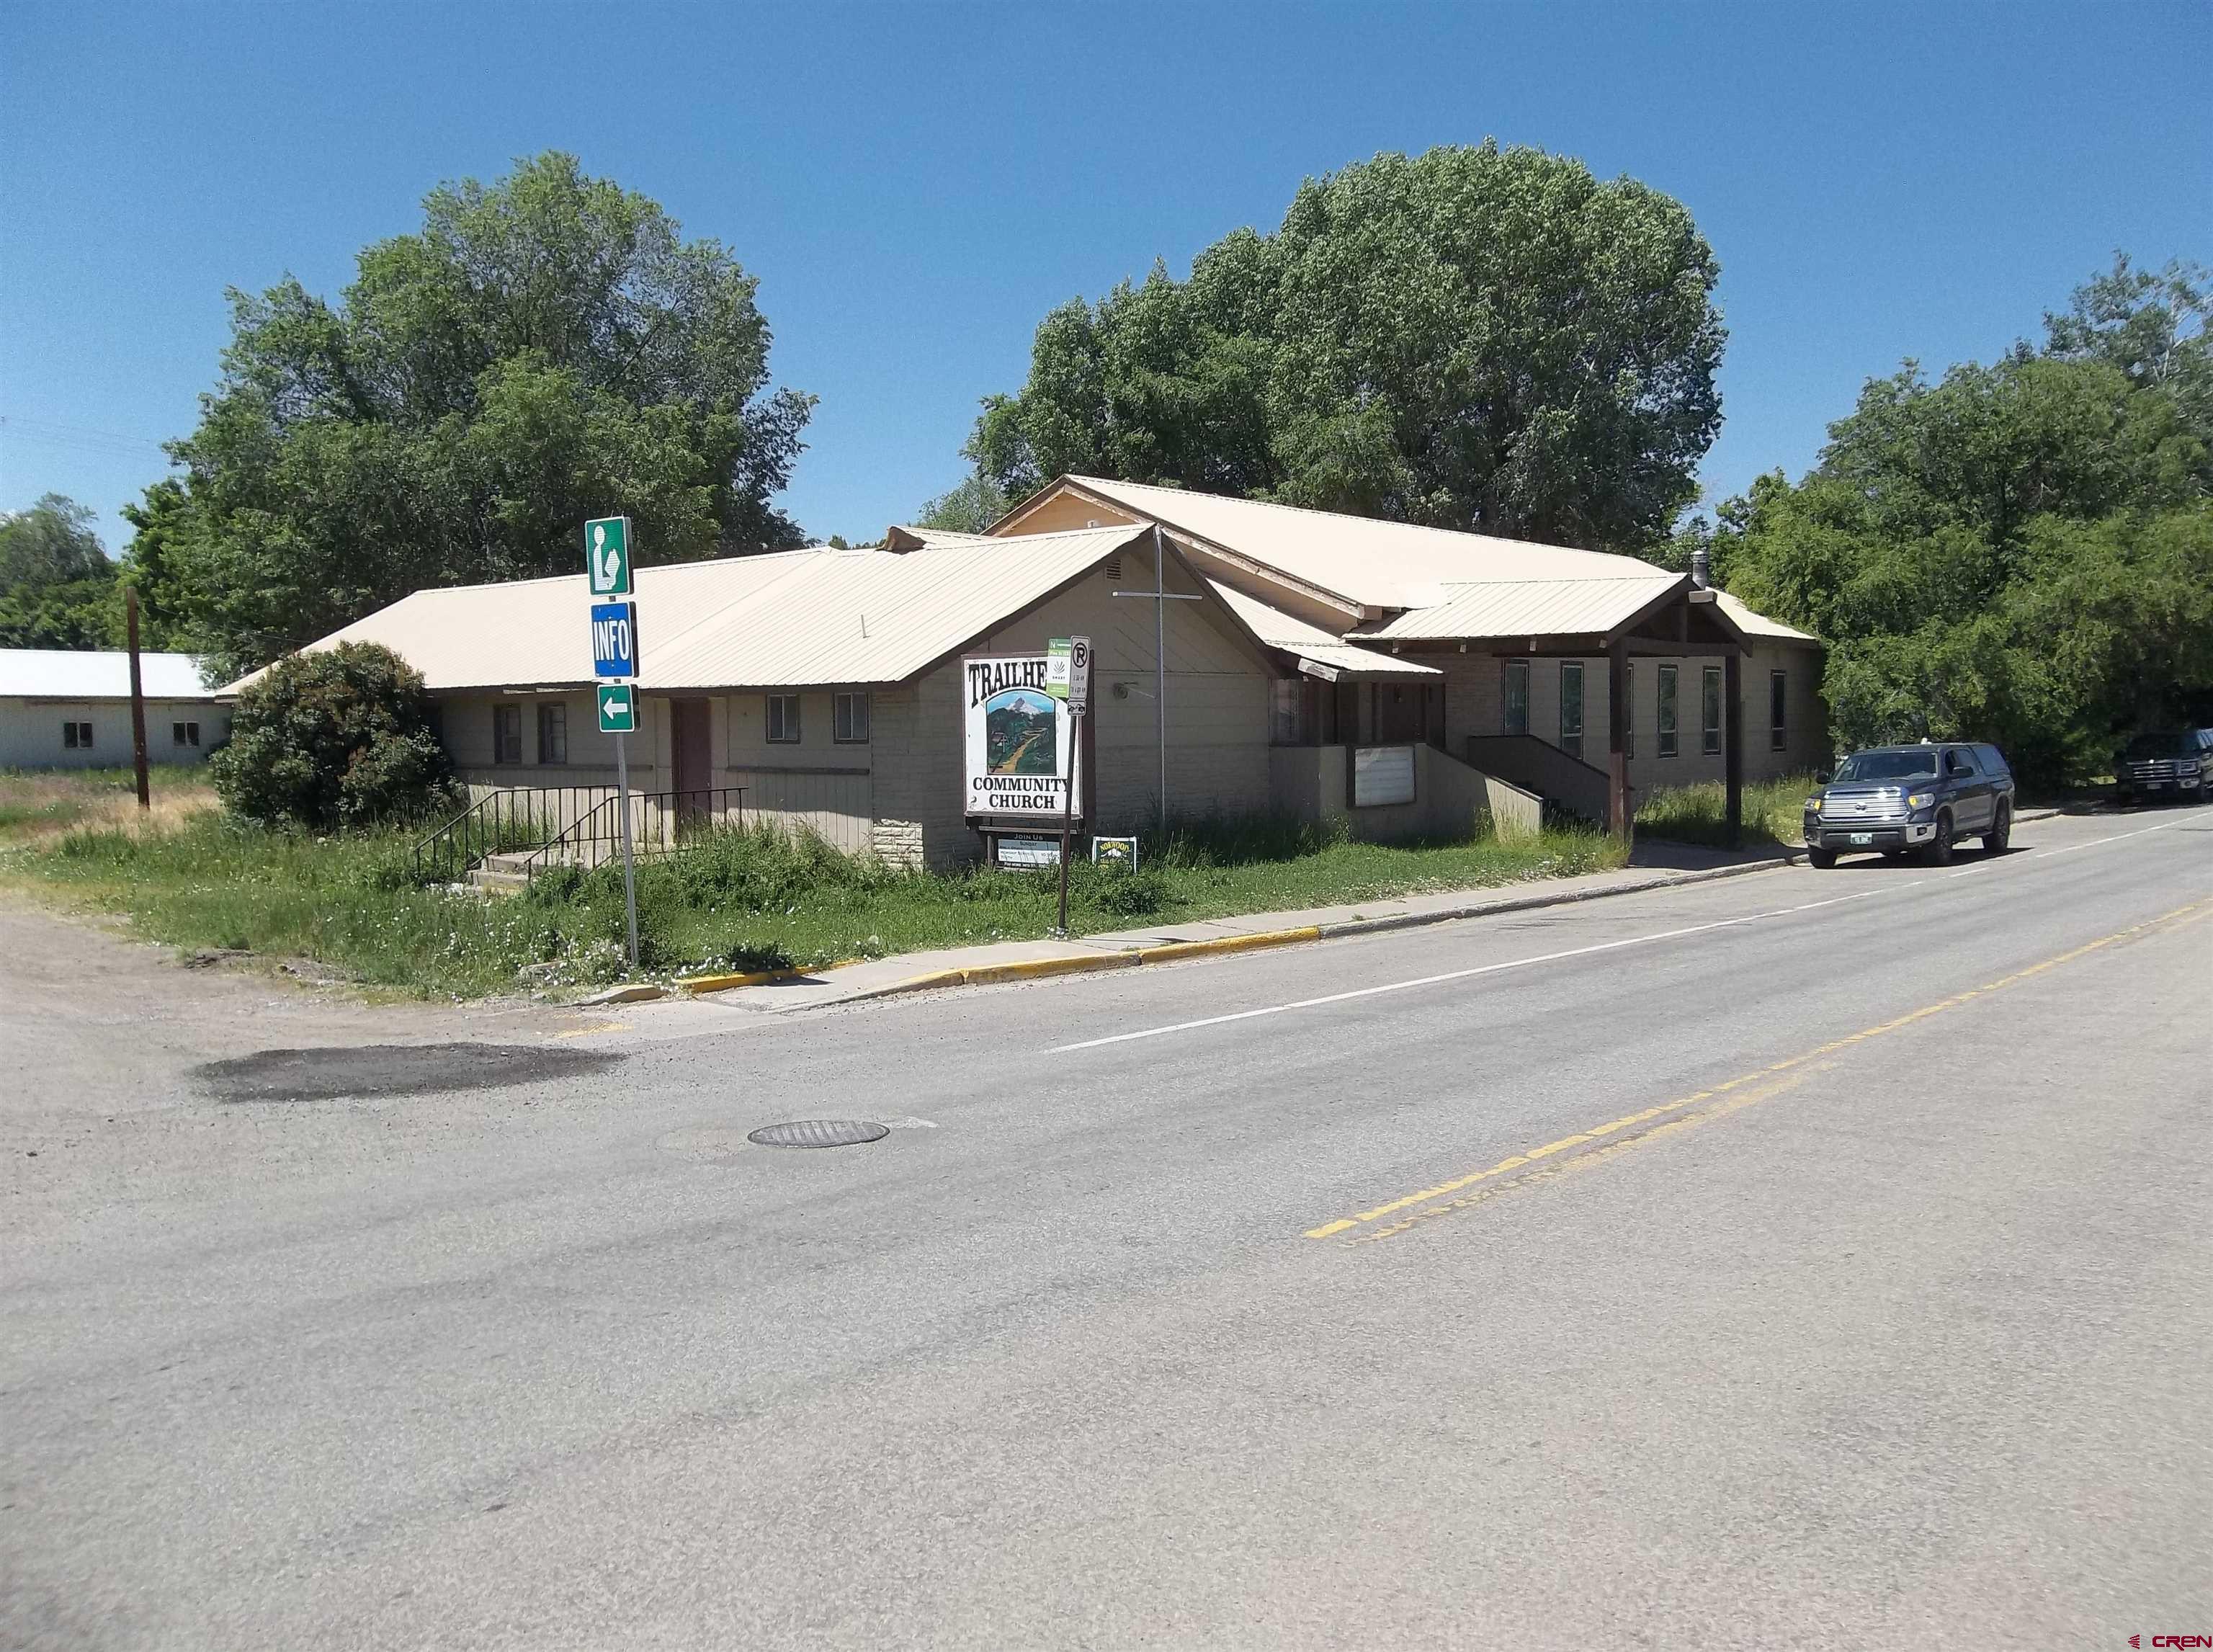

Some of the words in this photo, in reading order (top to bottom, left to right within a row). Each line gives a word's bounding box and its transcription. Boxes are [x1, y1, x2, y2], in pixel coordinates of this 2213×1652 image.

[594, 620, 629, 661] INFO
[968, 661, 1048, 709] TRAILHE
[973, 777, 1068, 792] COMMUNITY
[989, 794, 1055, 809] CHURCH
[1100, 841, 1130, 852] NORWOOD
